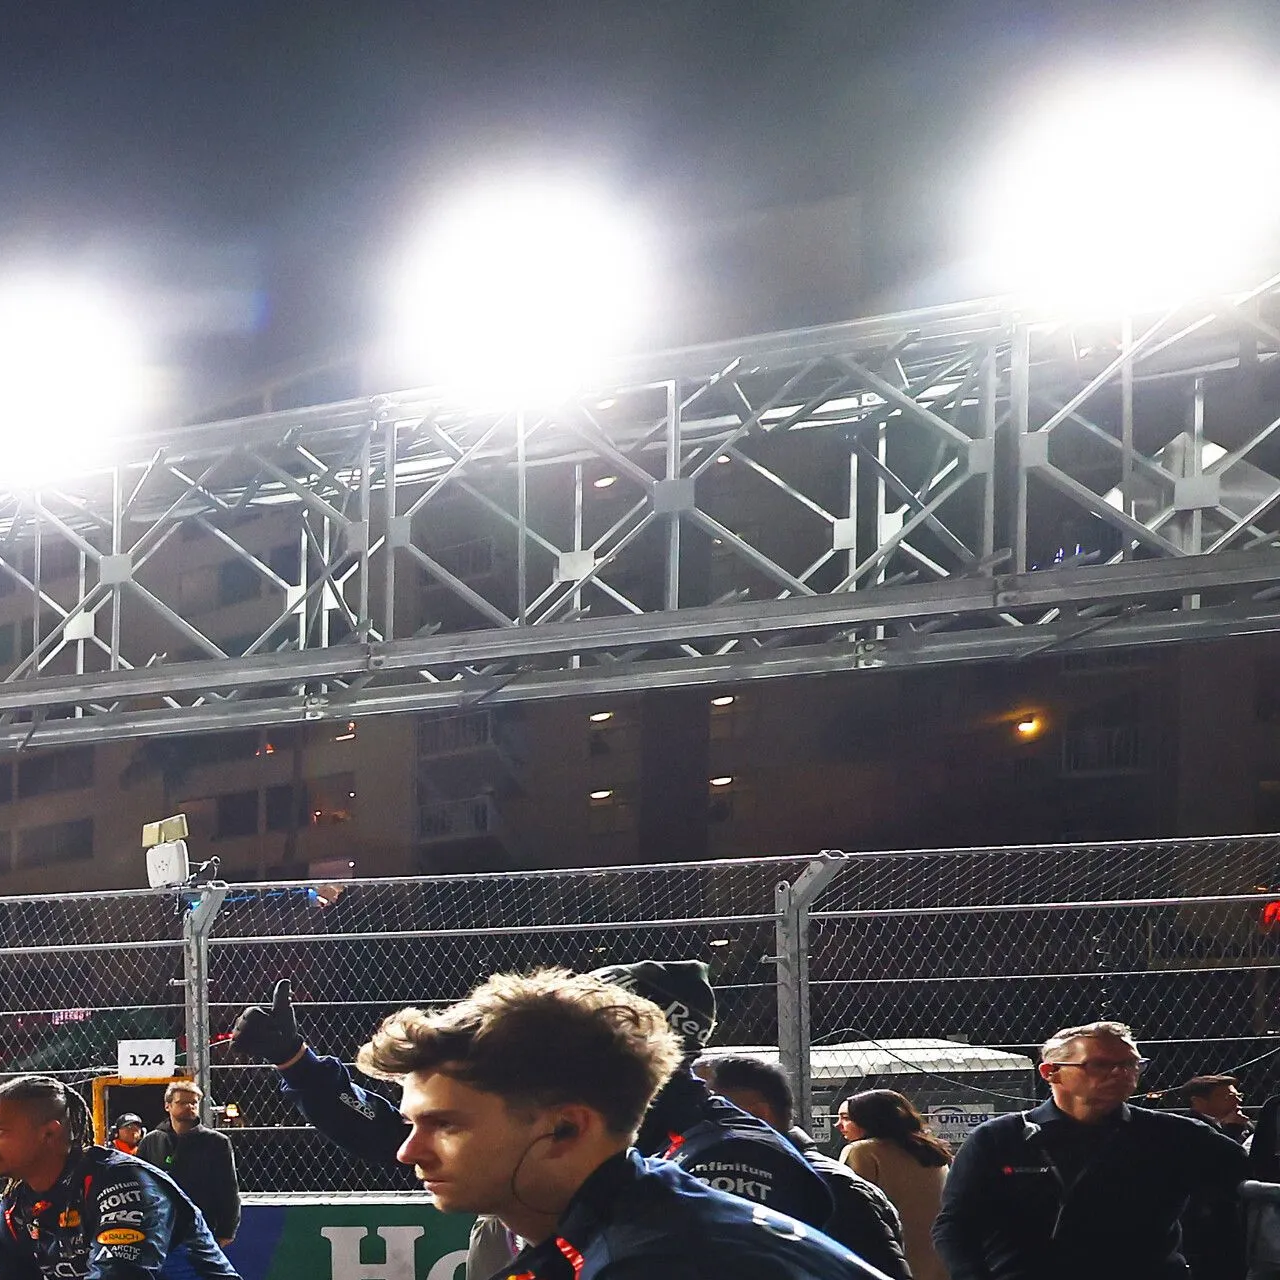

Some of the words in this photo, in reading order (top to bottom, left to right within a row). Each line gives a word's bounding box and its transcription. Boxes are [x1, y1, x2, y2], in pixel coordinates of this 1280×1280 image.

[129, 1054, 165, 1066] 17.4
[339, 1092, 376, 1120] sparco
[99, 1190, 141, 1212] ROKT
[108, 1233, 139, 1241] RAUCH
[110, 1244, 141, 1255] ARCTIC
[113, 1251, 138, 1261] WOLF
